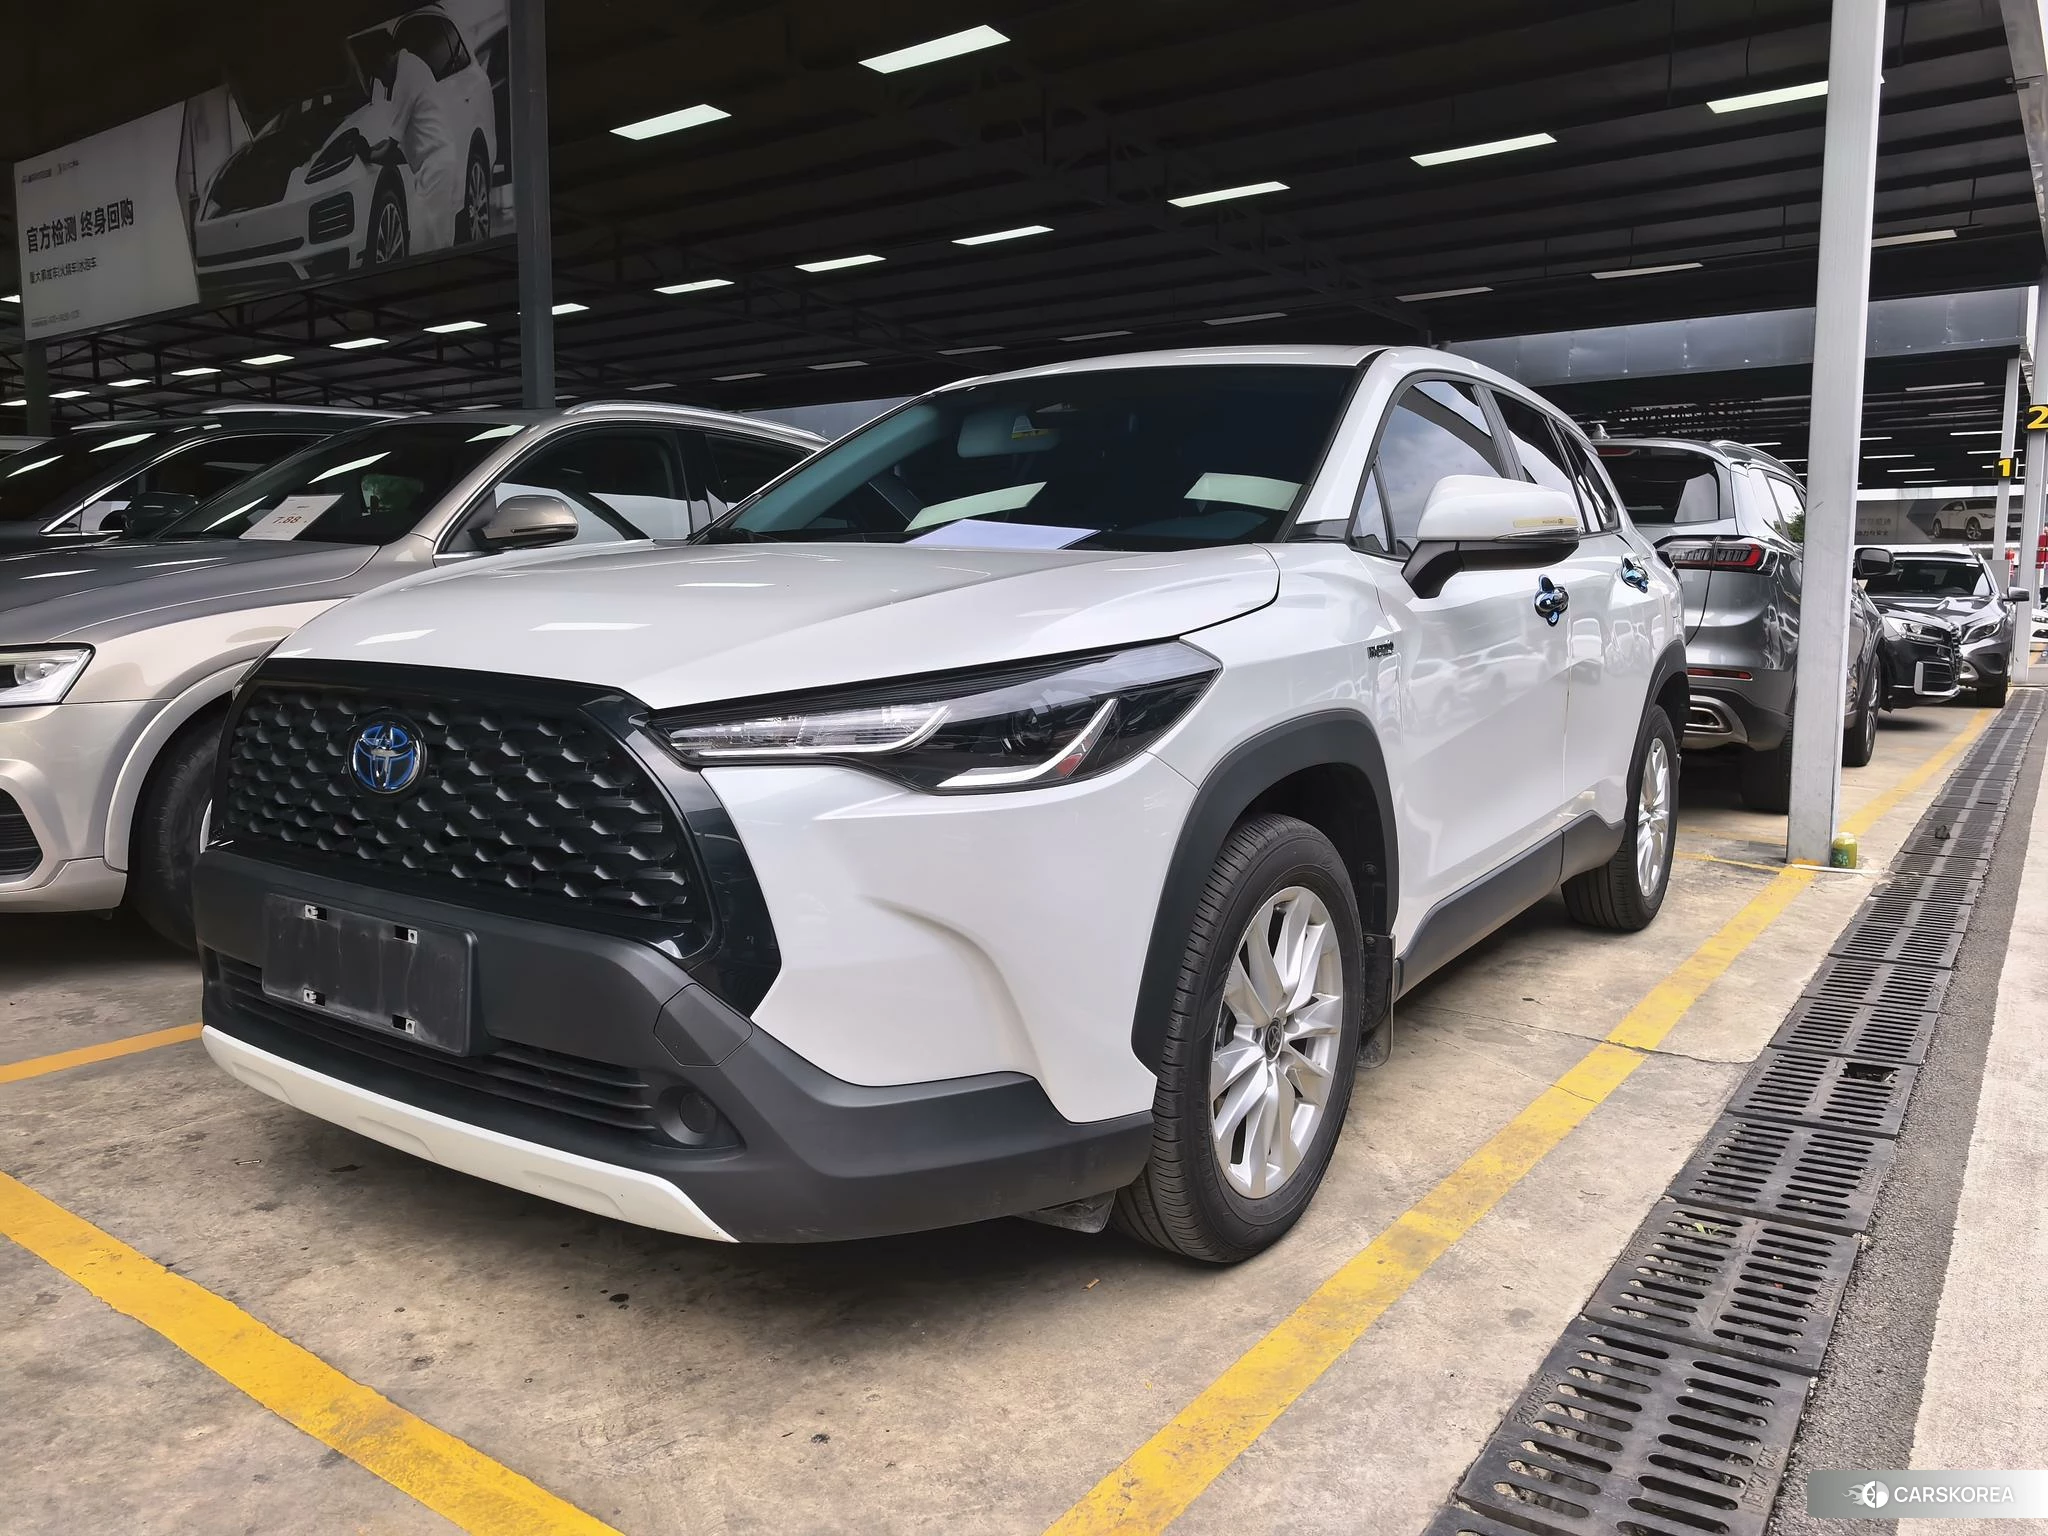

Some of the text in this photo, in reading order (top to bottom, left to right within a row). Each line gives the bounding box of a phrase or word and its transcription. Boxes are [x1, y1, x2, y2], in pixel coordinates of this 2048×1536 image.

[26, 198, 134, 253] 官方检测 终身回购
[2027, 405, 2048, 430] 2
[1998, 458, 2011, 477] 1
